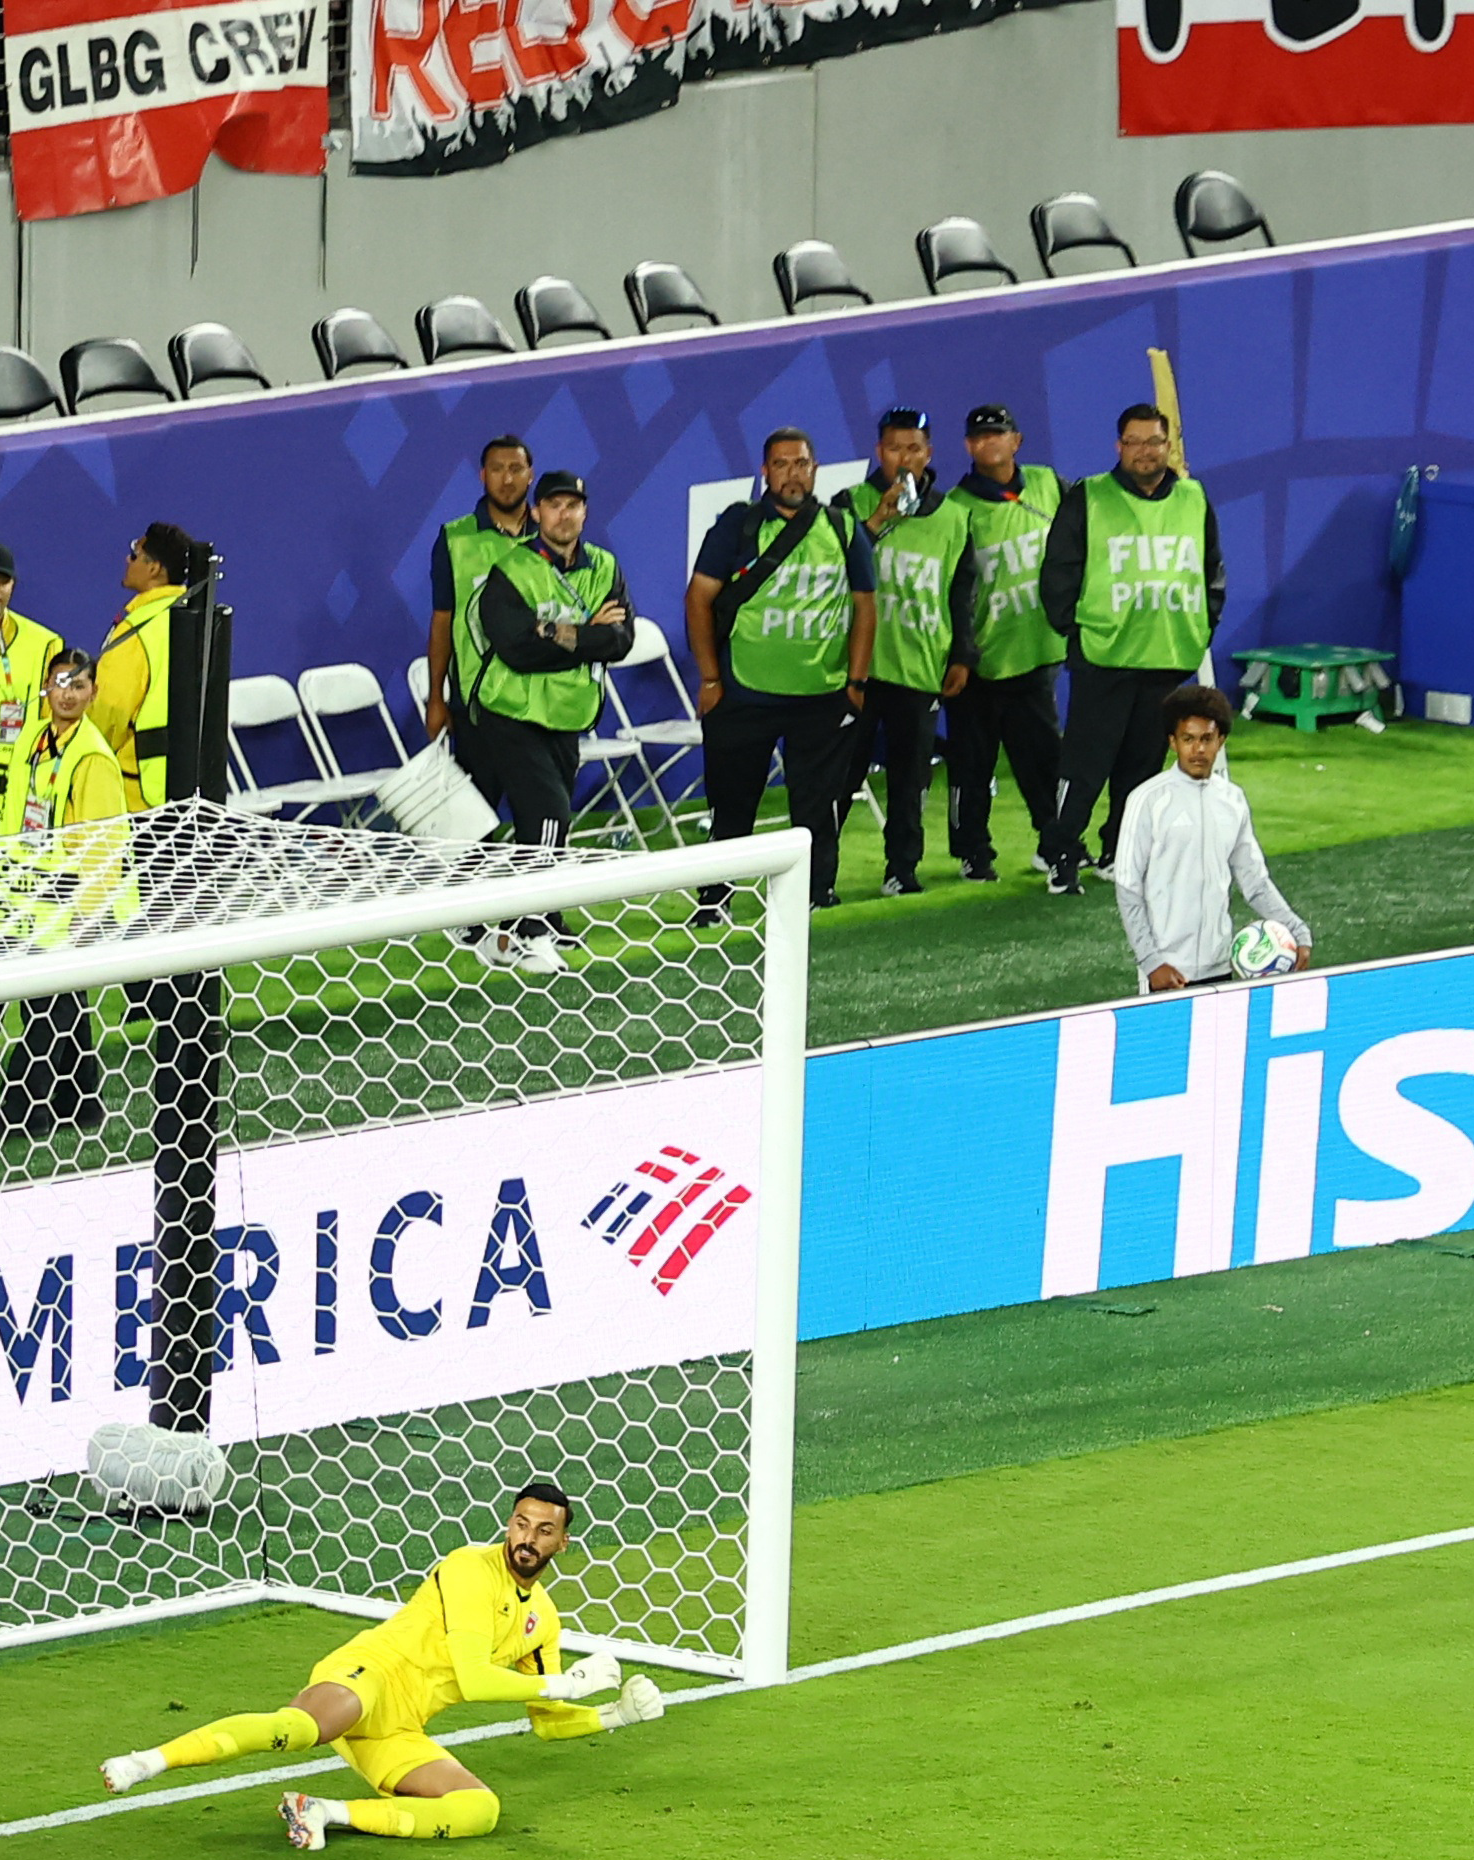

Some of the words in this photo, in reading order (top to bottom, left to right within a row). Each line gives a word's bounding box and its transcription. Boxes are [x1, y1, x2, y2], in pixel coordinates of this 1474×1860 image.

[18, 29, 166, 114] GLBG
[875, 545, 941, 596] IFA
[975, 527, 1049, 583] FIF
[1107, 535, 1202, 573] FIFA
[989, 580, 1039, 621] PIT
[1110, 582, 1202, 613] PITCH
